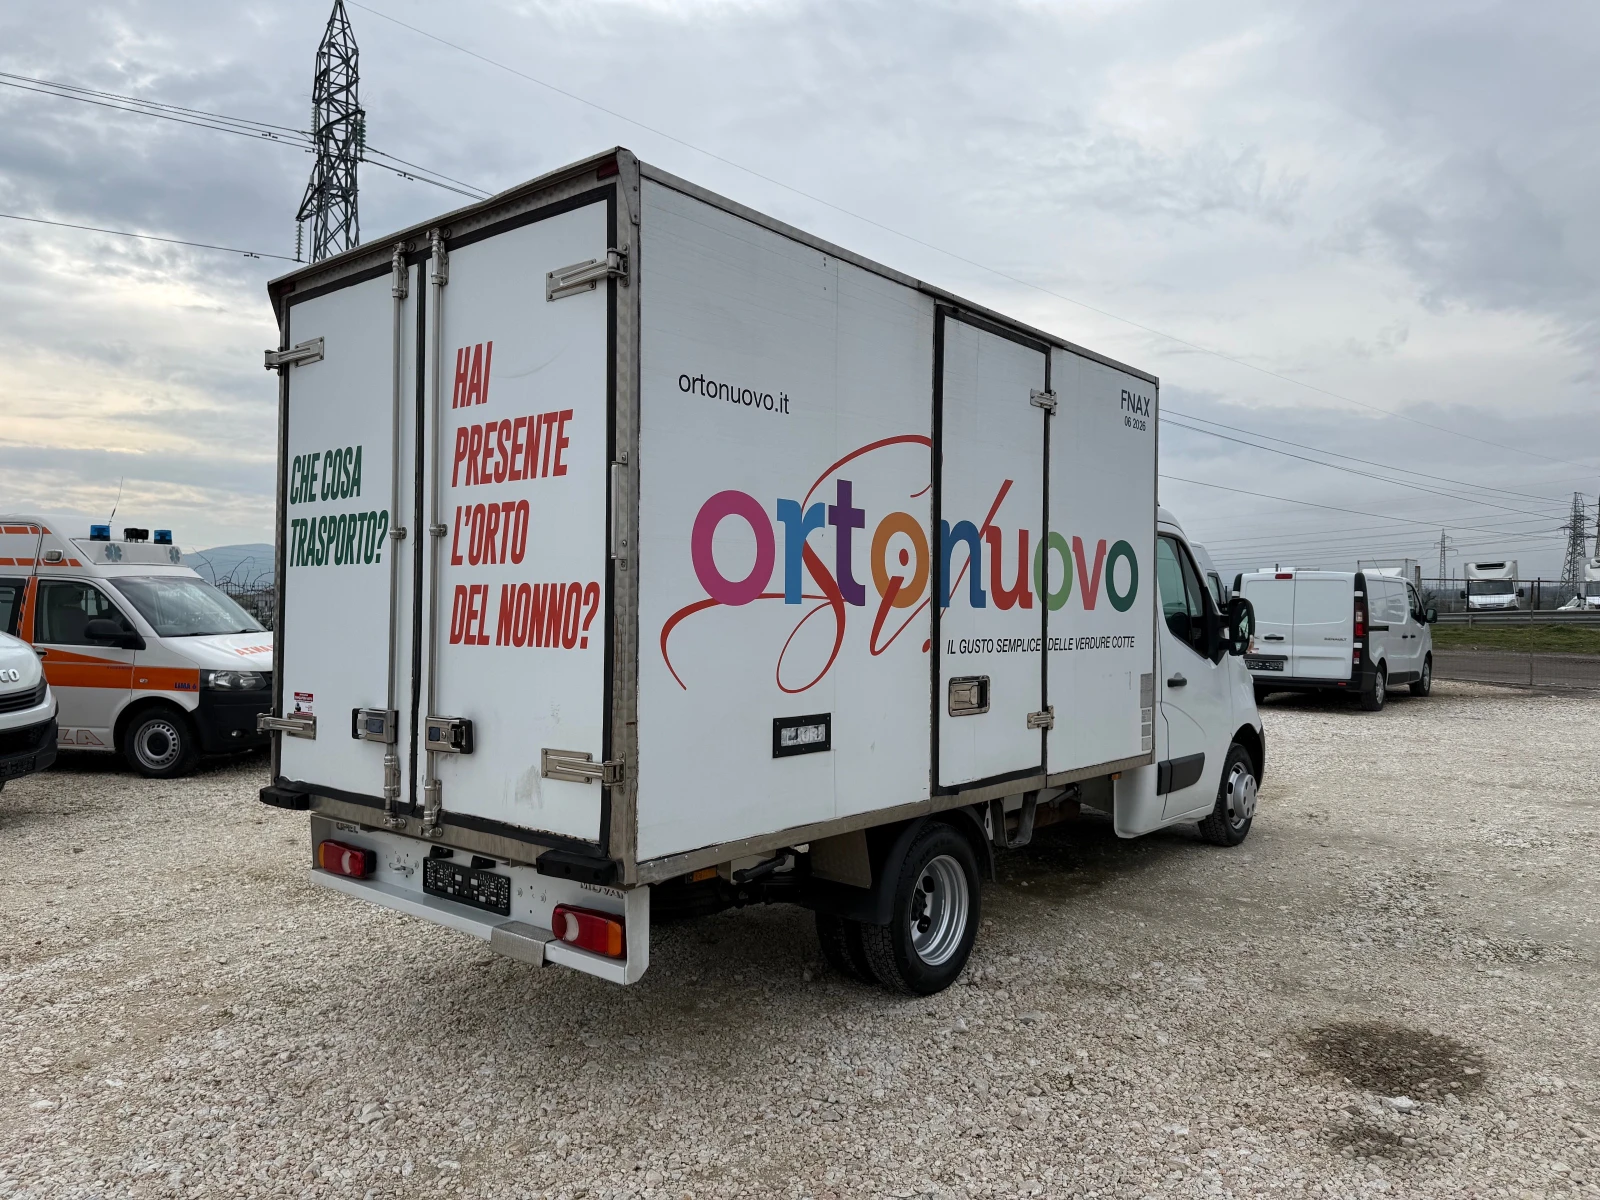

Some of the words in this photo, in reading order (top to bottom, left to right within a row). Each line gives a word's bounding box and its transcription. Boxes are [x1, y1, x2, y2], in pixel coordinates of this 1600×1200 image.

[453, 341, 493, 409] HAI
[678, 373, 790, 415] ortonuovo.it
[1121, 389, 1150, 417] FNAX
[452, 409, 574, 488] PRESENTE
[1125, 415, 1132, 427] 06
[1133, 418, 1146, 431] 2026
[289, 452, 320, 505] CHE
[321, 445, 363, 502] COSA
[289, 510, 389, 567] TRASPORTO?
[451, 499, 530, 566] L'ORTO
[690, 479, 1139, 613] ortonuovo
[449, 584, 490, 646] DEL
[495, 581, 601, 650] NONNO?
[946, 639, 957, 655] IL
[958, 638, 994, 654] GUSTO
[995, 637, 1042, 653] SEMPLICE
[1047, 637, 1074, 651] DELLE
[1075, 635, 1111, 650] VERDURE
[1111, 635, 1136, 649] COTTE
